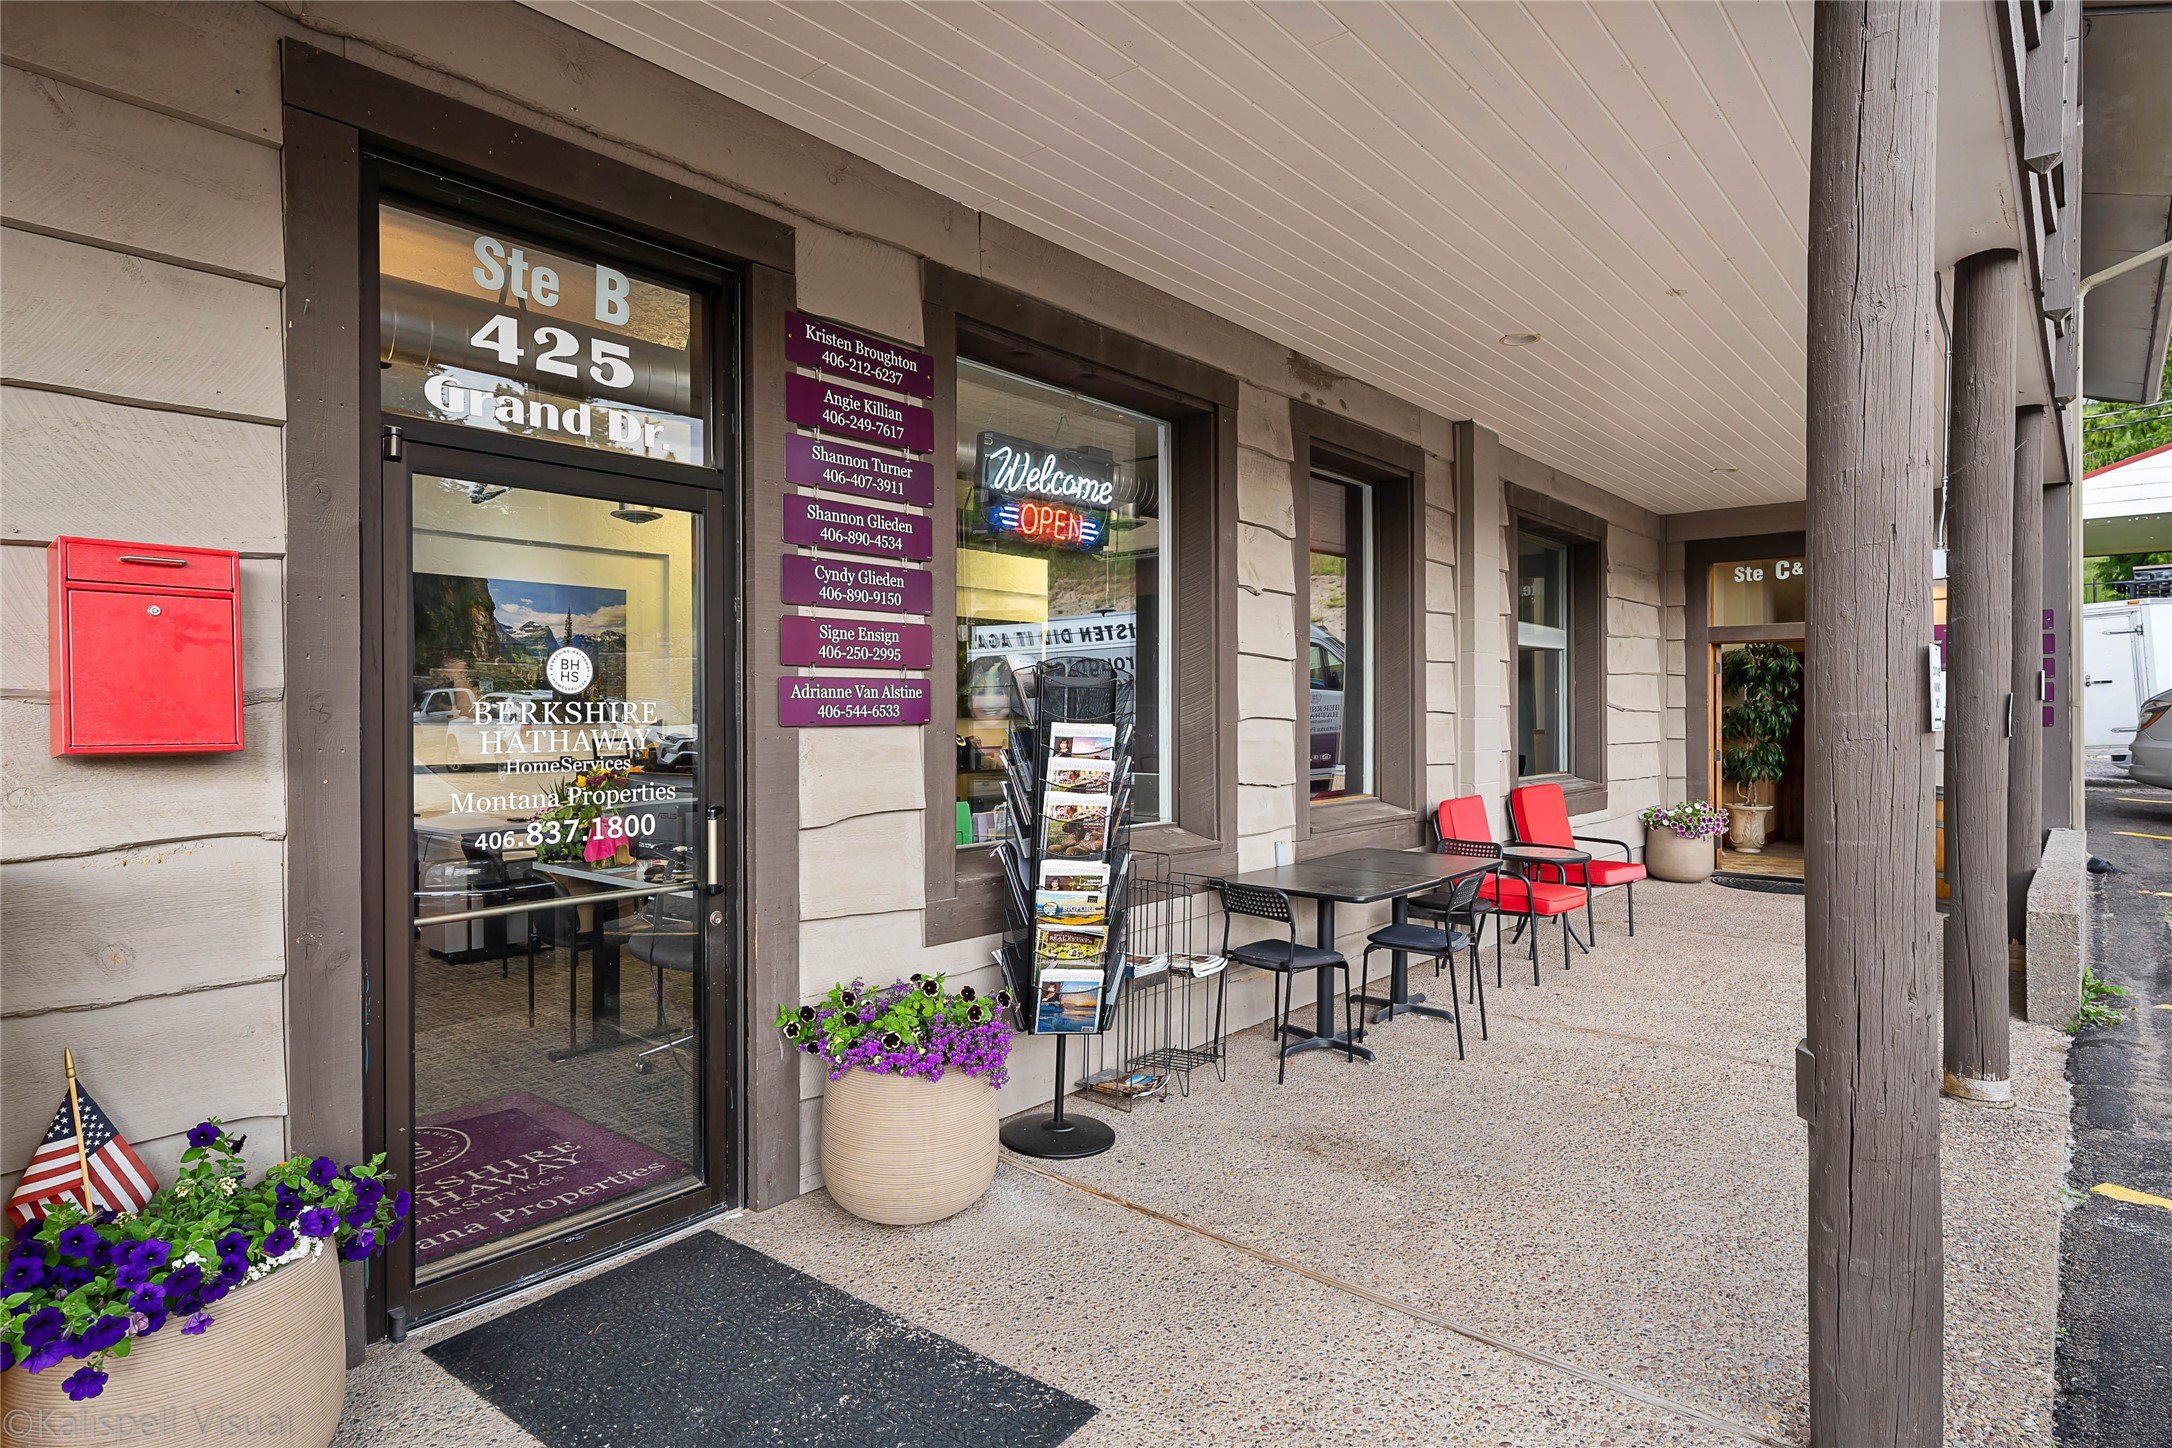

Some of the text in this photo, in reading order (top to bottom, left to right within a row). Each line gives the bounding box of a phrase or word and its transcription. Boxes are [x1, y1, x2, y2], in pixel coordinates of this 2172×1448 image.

[473, 236, 631, 326] Ste B
[470, 314, 634, 389] 425
[805, 324, 917, 372] Kristen Broughton
[822, 351, 903, 385] 406-212-6237
[424, 375, 670, 450] Grand Dr.
[824, 390, 903, 421] Angie Killian
[822, 410, 904, 439] 406-249-7617
[811, 446, 913, 479] Shannon Turner
[990, 446, 1113, 505] Welcome
[823, 469, 904, 495] 406-407-3911
[807, 505, 913, 534] Shannon Glieden
[1021, 503, 1083, 543] OPEN
[820, 527, 902, 550] 406-890-4534
[814, 565, 904, 588] Cyndy Glieden
[1734, 566, 1763, 582] Ste
[819, 586, 901, 605] 406-890-9150
[819, 625, 900, 645] Signe Ensign
[561, 659, 579, 670] BH
[818, 645, 901, 661] 406-250-2995
[561, 671, 579, 682] HS
[790, 684, 922, 699] Adrianne Van Alstine
[472, 702, 658, 726] BERKSHIRE
[817, 705, 900, 718] 406-544-6533
[480, 728, 652, 754] HATHAWAY
[506, 757, 631, 775] HomeServices
[449, 782, 676, 814] Montana Properties
[474, 813, 656, 850] 406.837.1800
[490, 1161, 666, 1225] Properties
